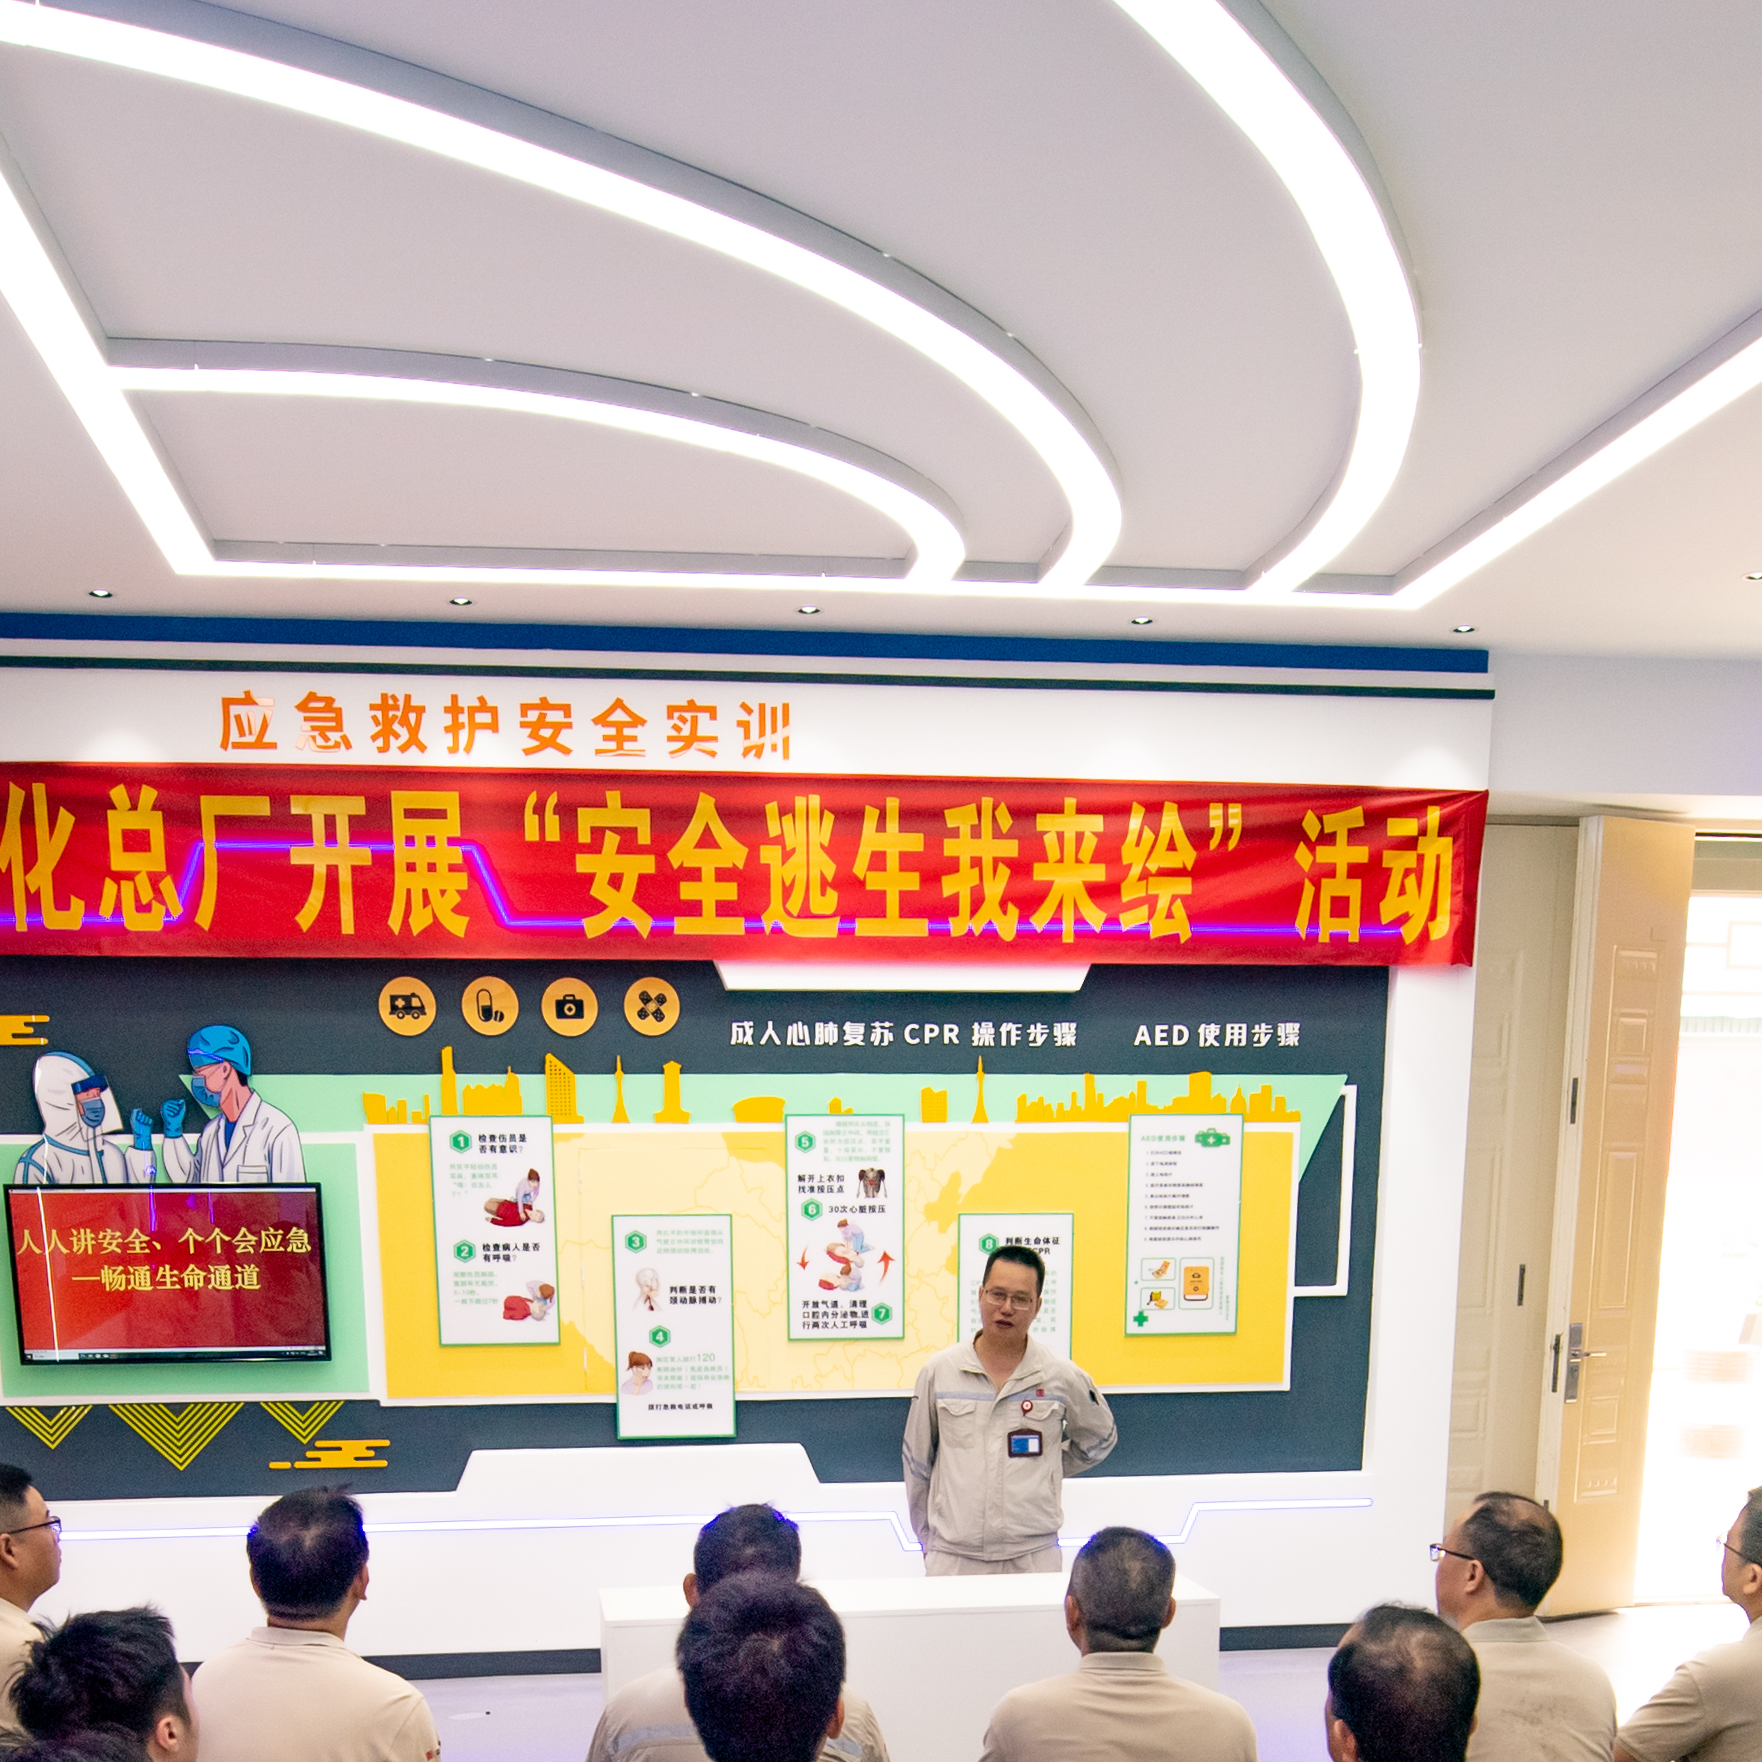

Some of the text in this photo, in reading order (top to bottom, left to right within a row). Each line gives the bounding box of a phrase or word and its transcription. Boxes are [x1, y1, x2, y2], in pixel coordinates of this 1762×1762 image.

[220, 689, 791, 762] 应急救护安全实训
[731, 1021, 1077, 1048] 成人心肺复苏 CPR 操作步骤
[1134, 1021, 1301, 1049] AED 使用步骤
[456, 1135, 465, 1148] 1
[801, 1136, 810, 1148] 5
[807, 1204, 817, 1215] 6
[17, 1226, 312, 1257] 人人讲安全、个个会应急
[631, 1236, 641, 1248] 3
[984, 1238, 994, 1250] 8
[460, 1245, 470, 1257] 2
[878, 1308, 886, 1319] 7
[655, 1331, 665, 1342] 4
